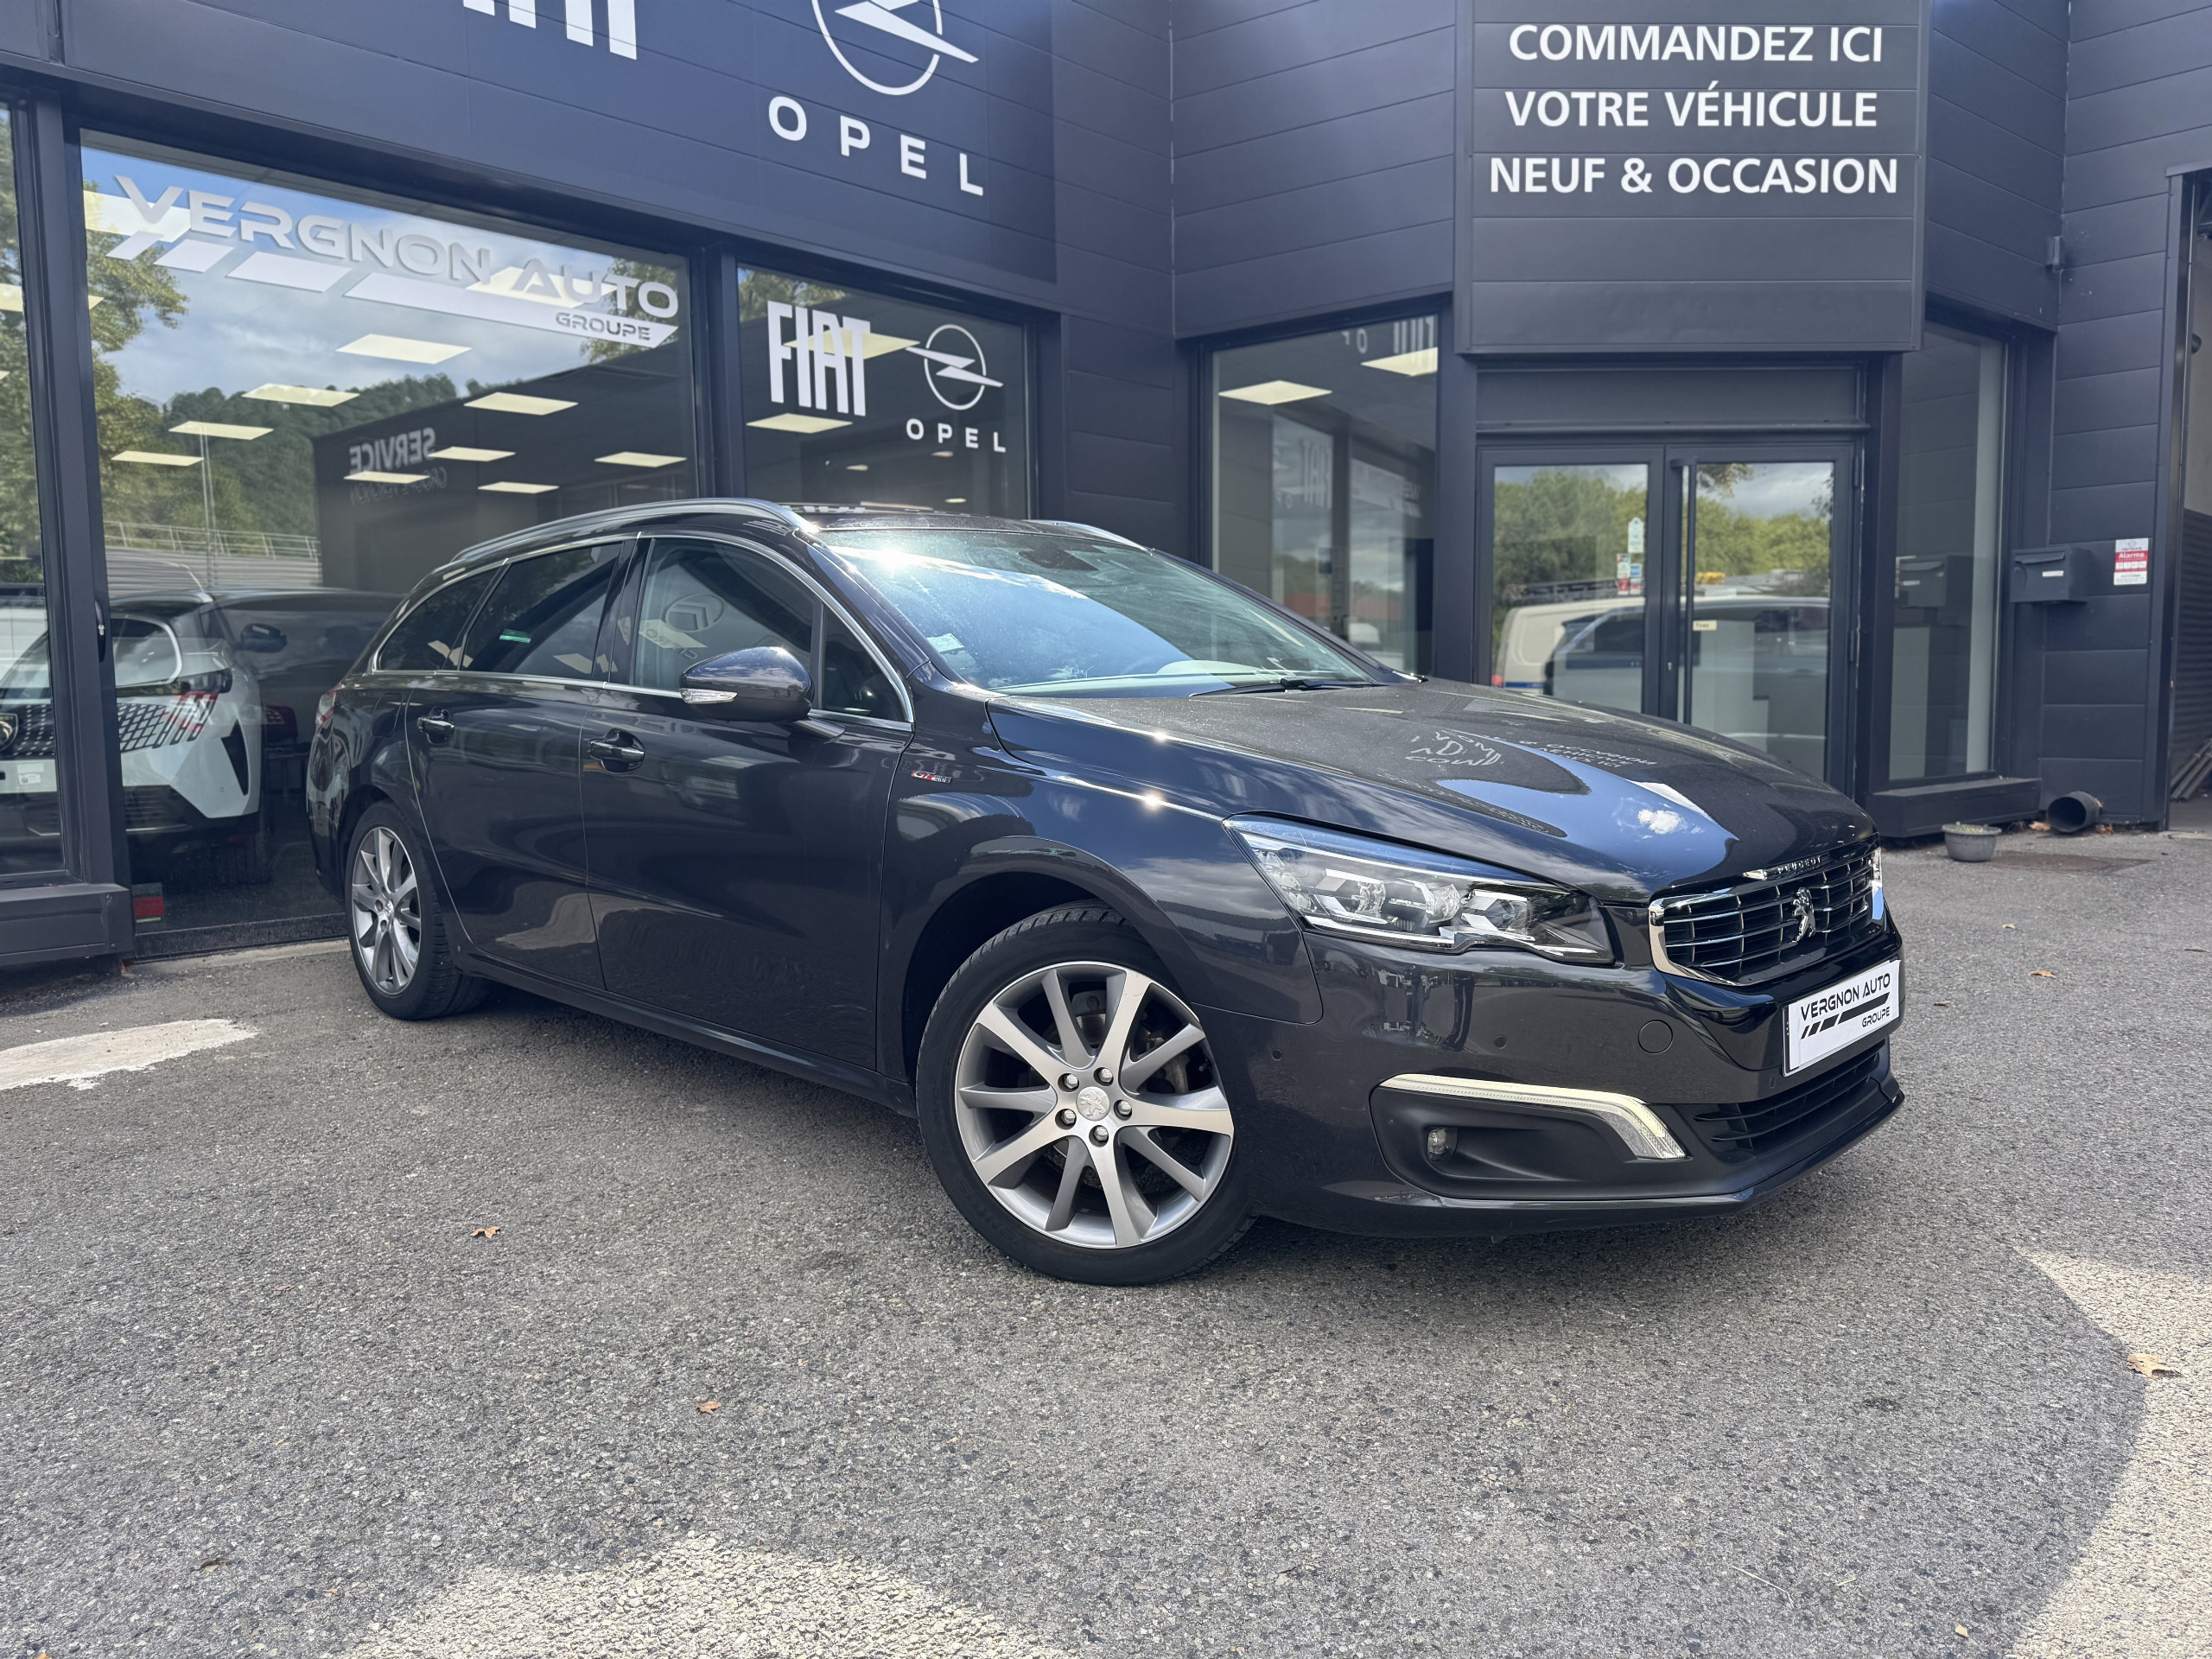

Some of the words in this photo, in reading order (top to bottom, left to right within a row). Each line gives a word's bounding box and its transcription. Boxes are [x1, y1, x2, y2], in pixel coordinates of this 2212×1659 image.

[1509, 24, 1813, 62] COMMANDEZ
[1829, 27, 1882, 62] ICI
[1504, 91, 1649, 128] VOTRE
[1664, 80, 1878, 128] VÉHICULE
[768, 96, 983, 196] OPEL
[1490, 157, 1605, 194] NEUF
[1621, 157, 1651, 194] &
[1668, 157, 1898, 194] OCCASION
[115, 175, 492, 285] VERGNON
[512, 258, 680, 318] AUTO
[555, 311, 652, 341] GROUPE
[767, 300, 871, 416] FIAT
[906, 418, 1007, 453] OPEL
[1777, 855, 1821, 874] PEUGEOT
[1800, 984, 1859, 1021] VERGNON
[1862, 973, 1891, 998] AUTO
[1861, 1007, 1891, 1027] GROUPE
